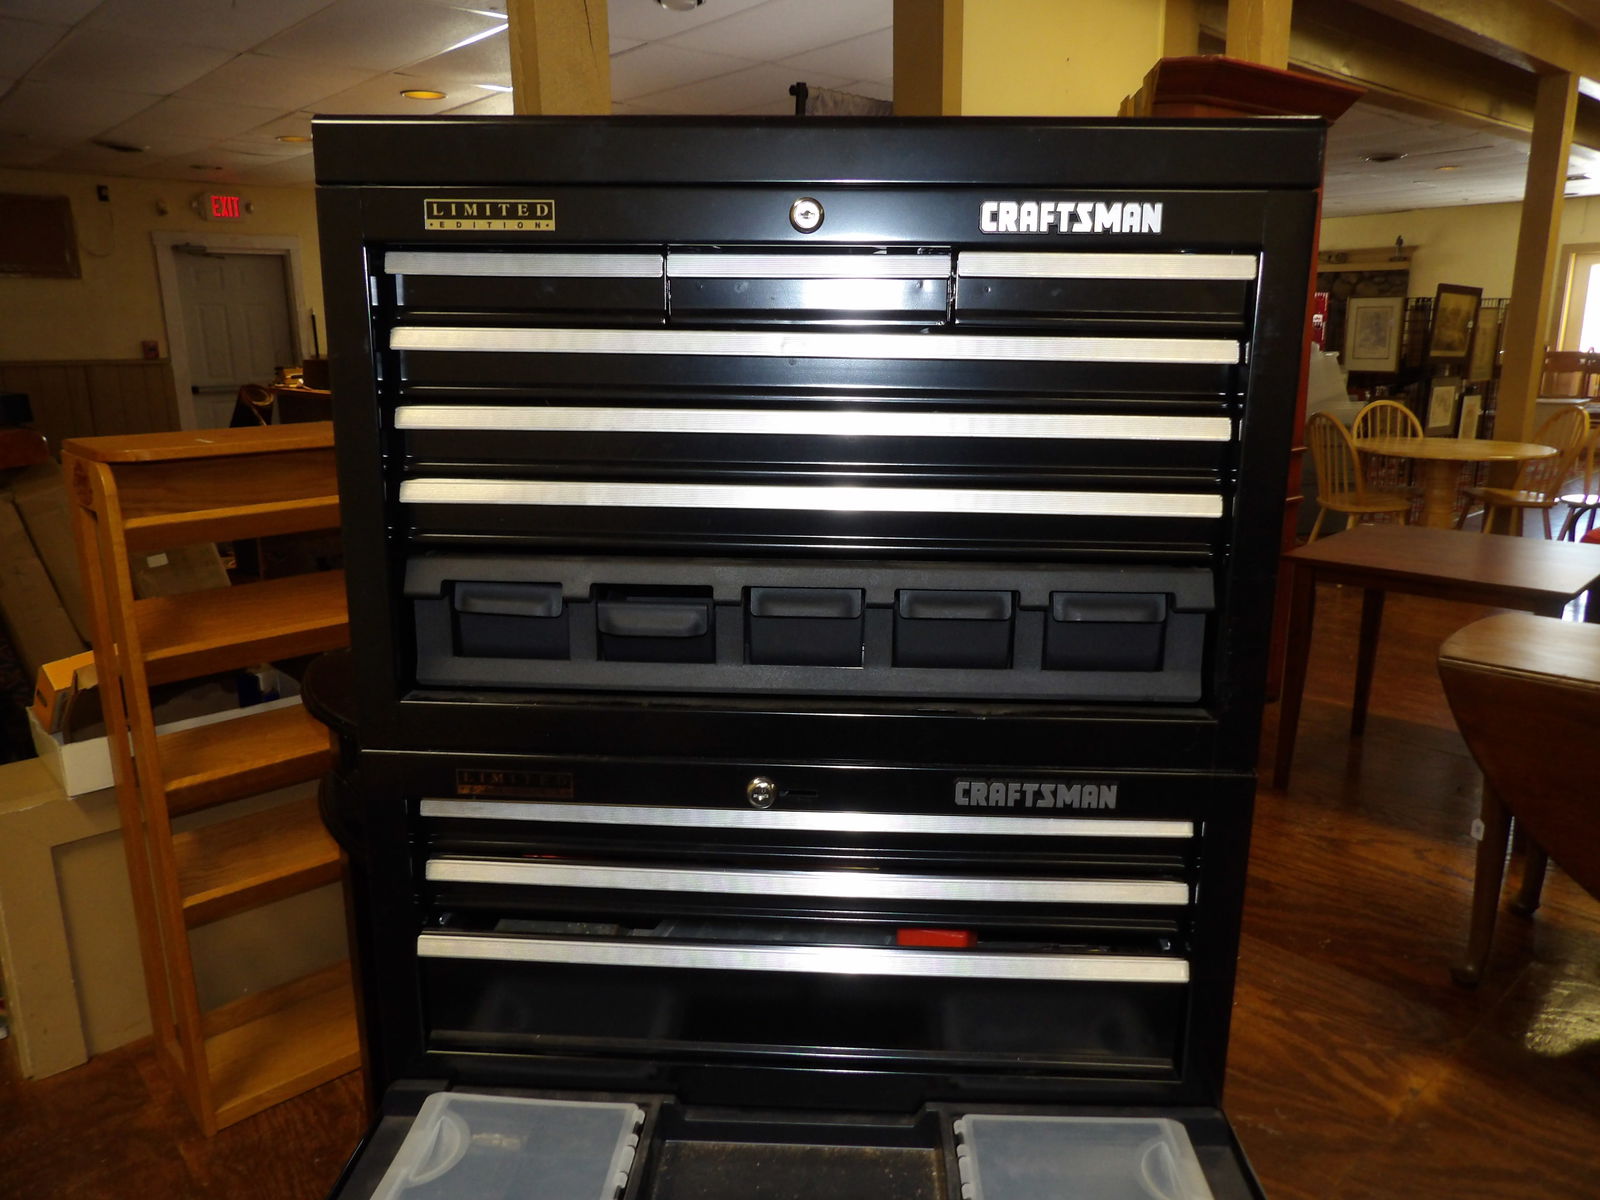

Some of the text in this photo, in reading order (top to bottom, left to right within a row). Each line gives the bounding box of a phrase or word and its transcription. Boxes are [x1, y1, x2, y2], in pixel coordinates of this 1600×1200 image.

[210, 195, 240, 217] EXIT
[432, 203, 549, 217] LIMITED
[439, 221, 541, 229] EDITION
[979, 201, 1163, 234] CRAFTSMAN
[954, 781, 1118, 810] CRAFTSMAN
